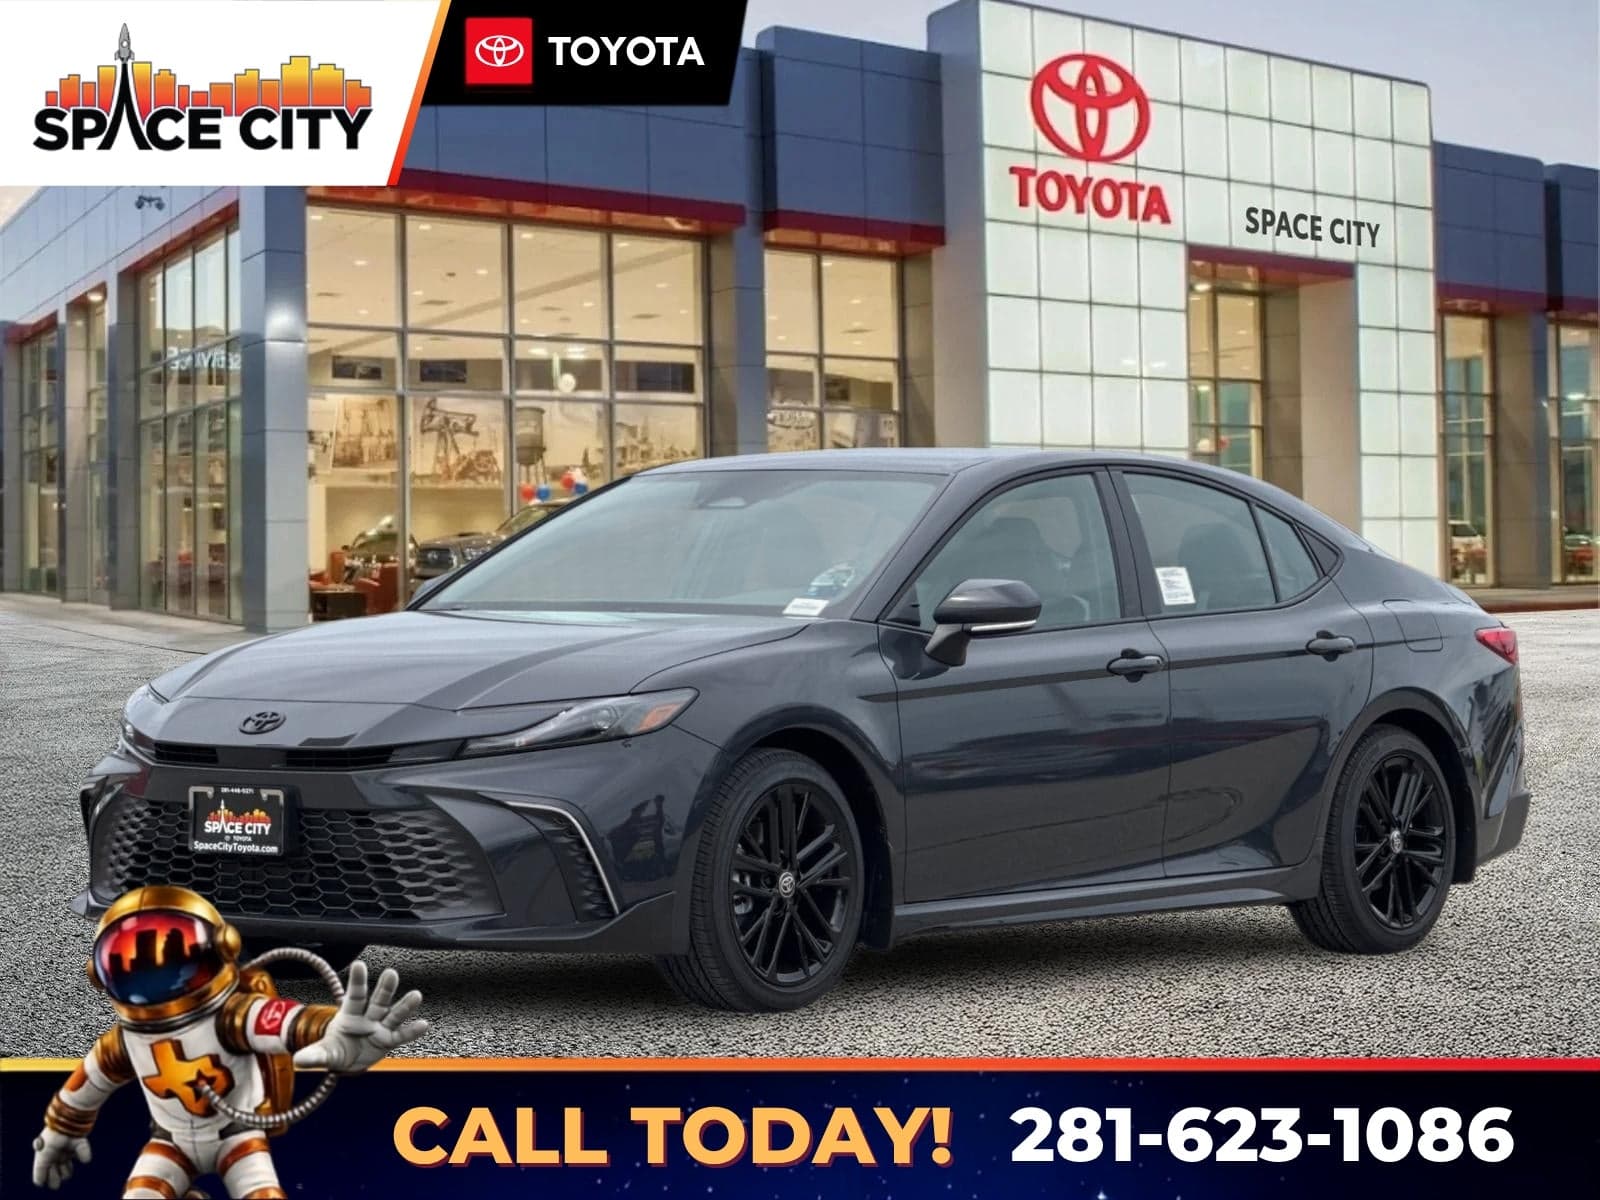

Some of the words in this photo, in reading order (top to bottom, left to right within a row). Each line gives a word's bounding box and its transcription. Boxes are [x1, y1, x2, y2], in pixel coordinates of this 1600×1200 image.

[1009, 166, 1171, 224] TOYOTA
[1245, 206, 1322, 242] SPACE
[1329, 218, 1381, 248] CITY
[204, 820, 243, 834] SPACE
[244, 821, 272, 835] CITY
[193, 840, 278, 854] SpaceCityToyota.com
